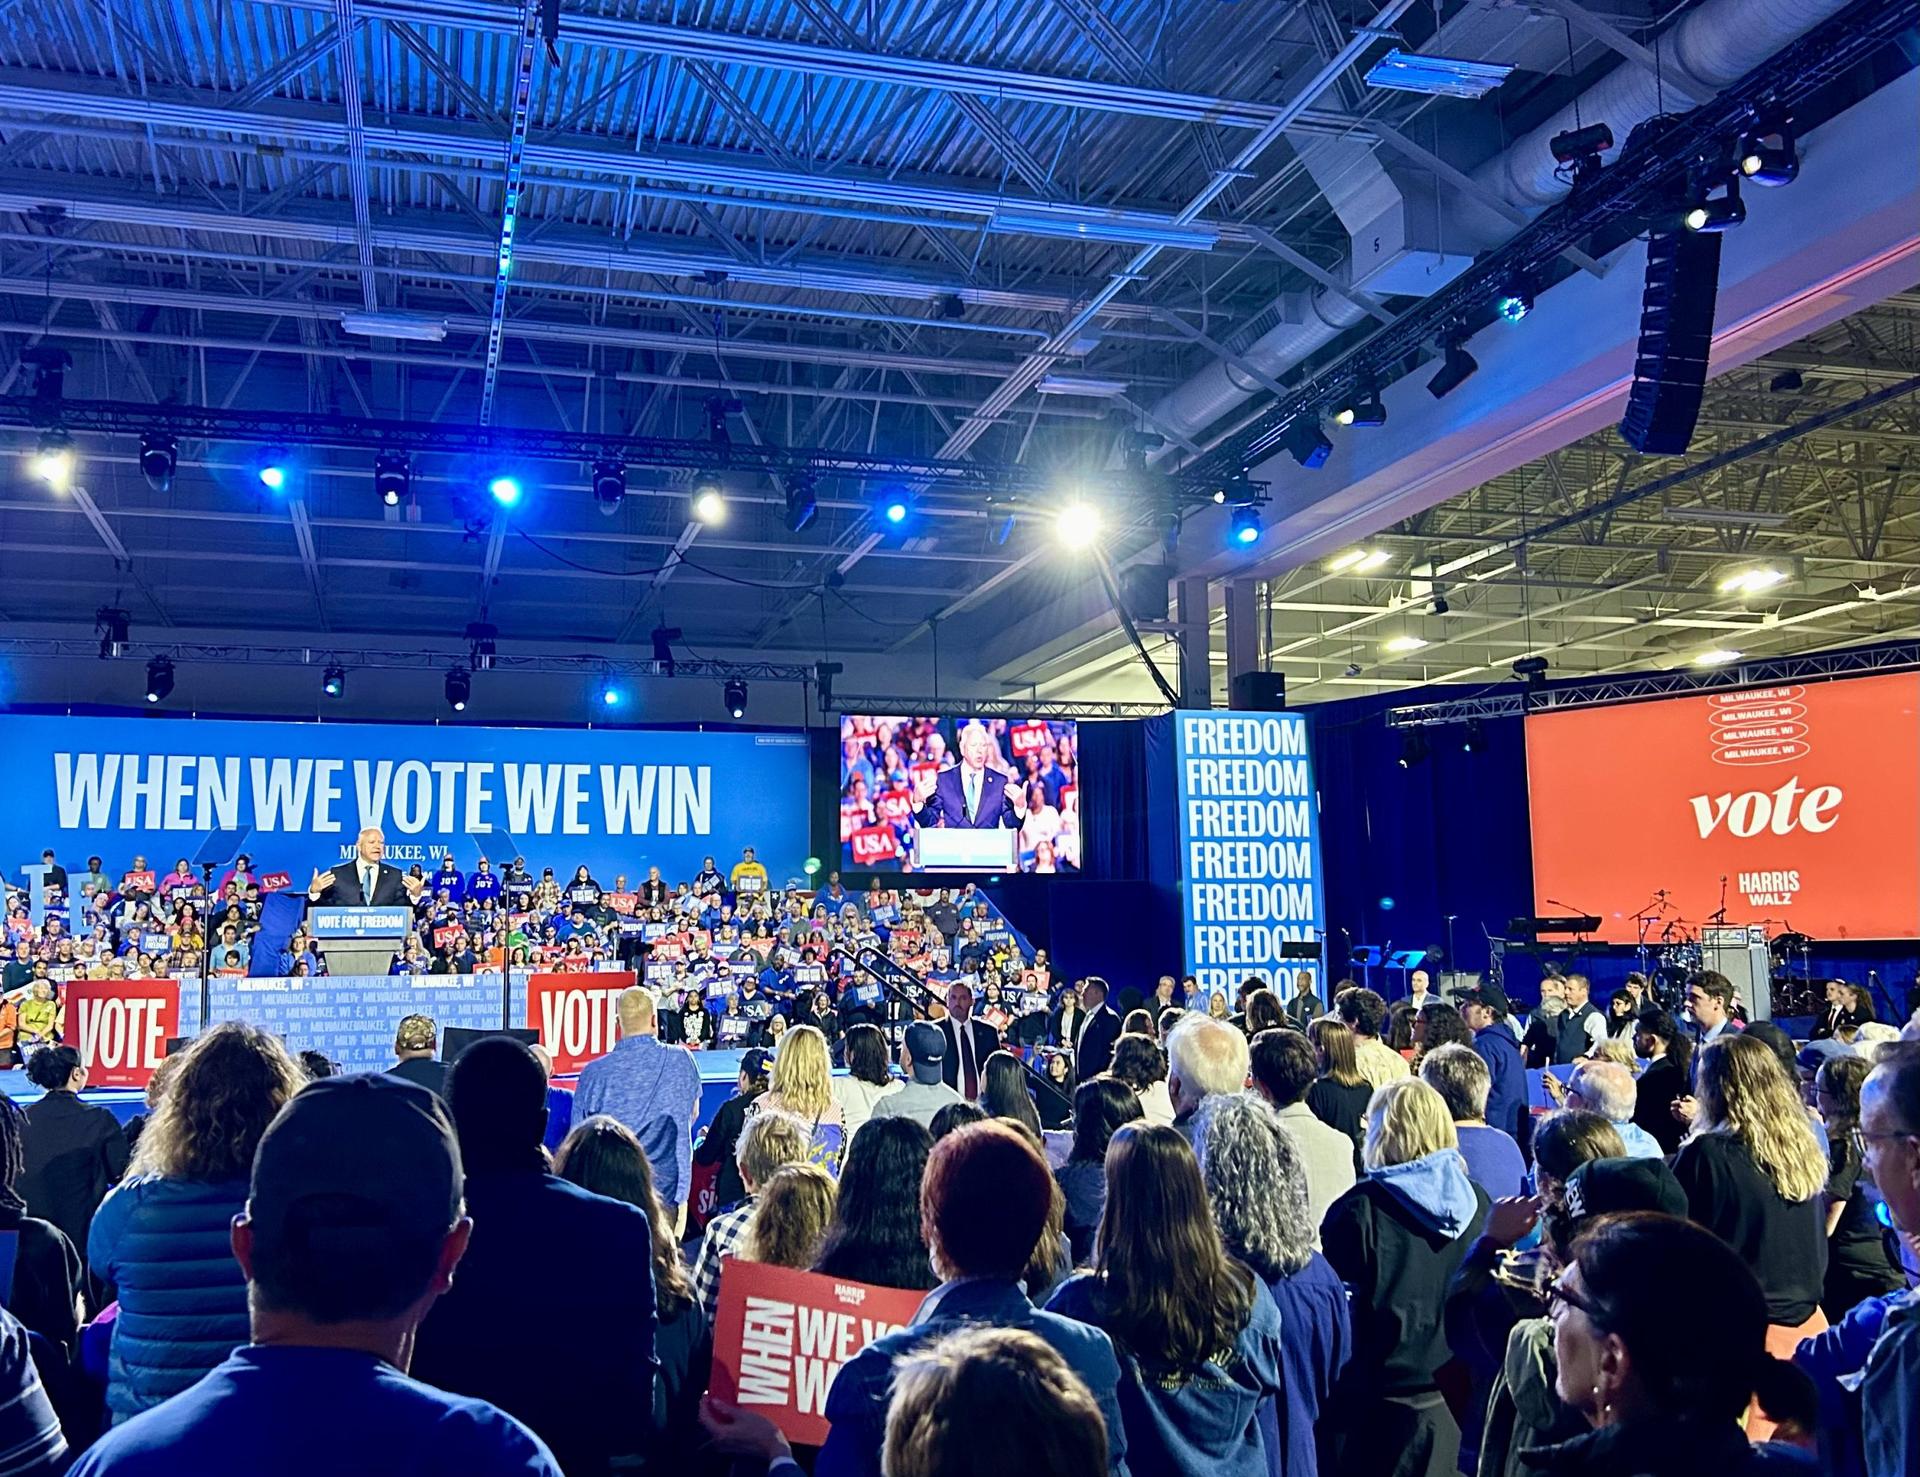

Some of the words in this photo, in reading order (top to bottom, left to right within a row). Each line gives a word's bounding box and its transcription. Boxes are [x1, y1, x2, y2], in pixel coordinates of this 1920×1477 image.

[1720, 690, 1776, 703] MILWAUKEE,
[1777, 688, 1790, 697] WI
[1722, 709, 1777, 721] MILWAUKEE,
[1779, 707, 1792, 715] WI
[1014, 730, 1045, 746] USA
[1184, 718, 1306, 755] FREEDOM
[1723, 728, 1779, 740] MILWAUKEE,
[1781, 726, 1793, 734] WI
[1724, 747, 1781, 759] MILWAUKEE,
[1186, 759, 1308, 796] FREEDOM
[54, 753, 240, 831] WHEN
[250, 757, 344, 832] WE
[353, 760, 494, 834] VOTE
[503, 763, 591, 835] WE
[600, 765, 711, 835] WIN
[1688, 776, 1843, 839] vote
[1188, 800, 1310, 837] FREEDOM
[430, 845, 449, 860] WI
[855, 834, 892, 855] USA
[1190, 842, 1312, 879] FREEDOM
[263, 877, 290, 888] USA
[440, 877, 458, 886] JOY
[476, 880, 493, 889] JOY
[1738, 870, 1800, 893] HARRIS
[614, 898, 637, 909] USA
[1192, 883, 1314, 921] FREEDOM
[1749, 893, 1792, 906] WALZ
[317, 915, 340, 929] VOTE
[342, 915, 360, 929] FOR
[362, 915, 403, 928] FREEDOM
[436, 930, 461, 944] USA
[237, 979, 289, 992] MILWAUKEE,
[291, 979, 304, 990] WI
[411, 976, 461, 988] MILWAUKEE,
[463, 976, 475, 987] WI
[78, 998, 167, 1069] VOTE
[834, 1284, 866, 1300] HARRIS
[798, 1305, 856, 1361] WE
[737, 1296, 796, 1406] WHEN
